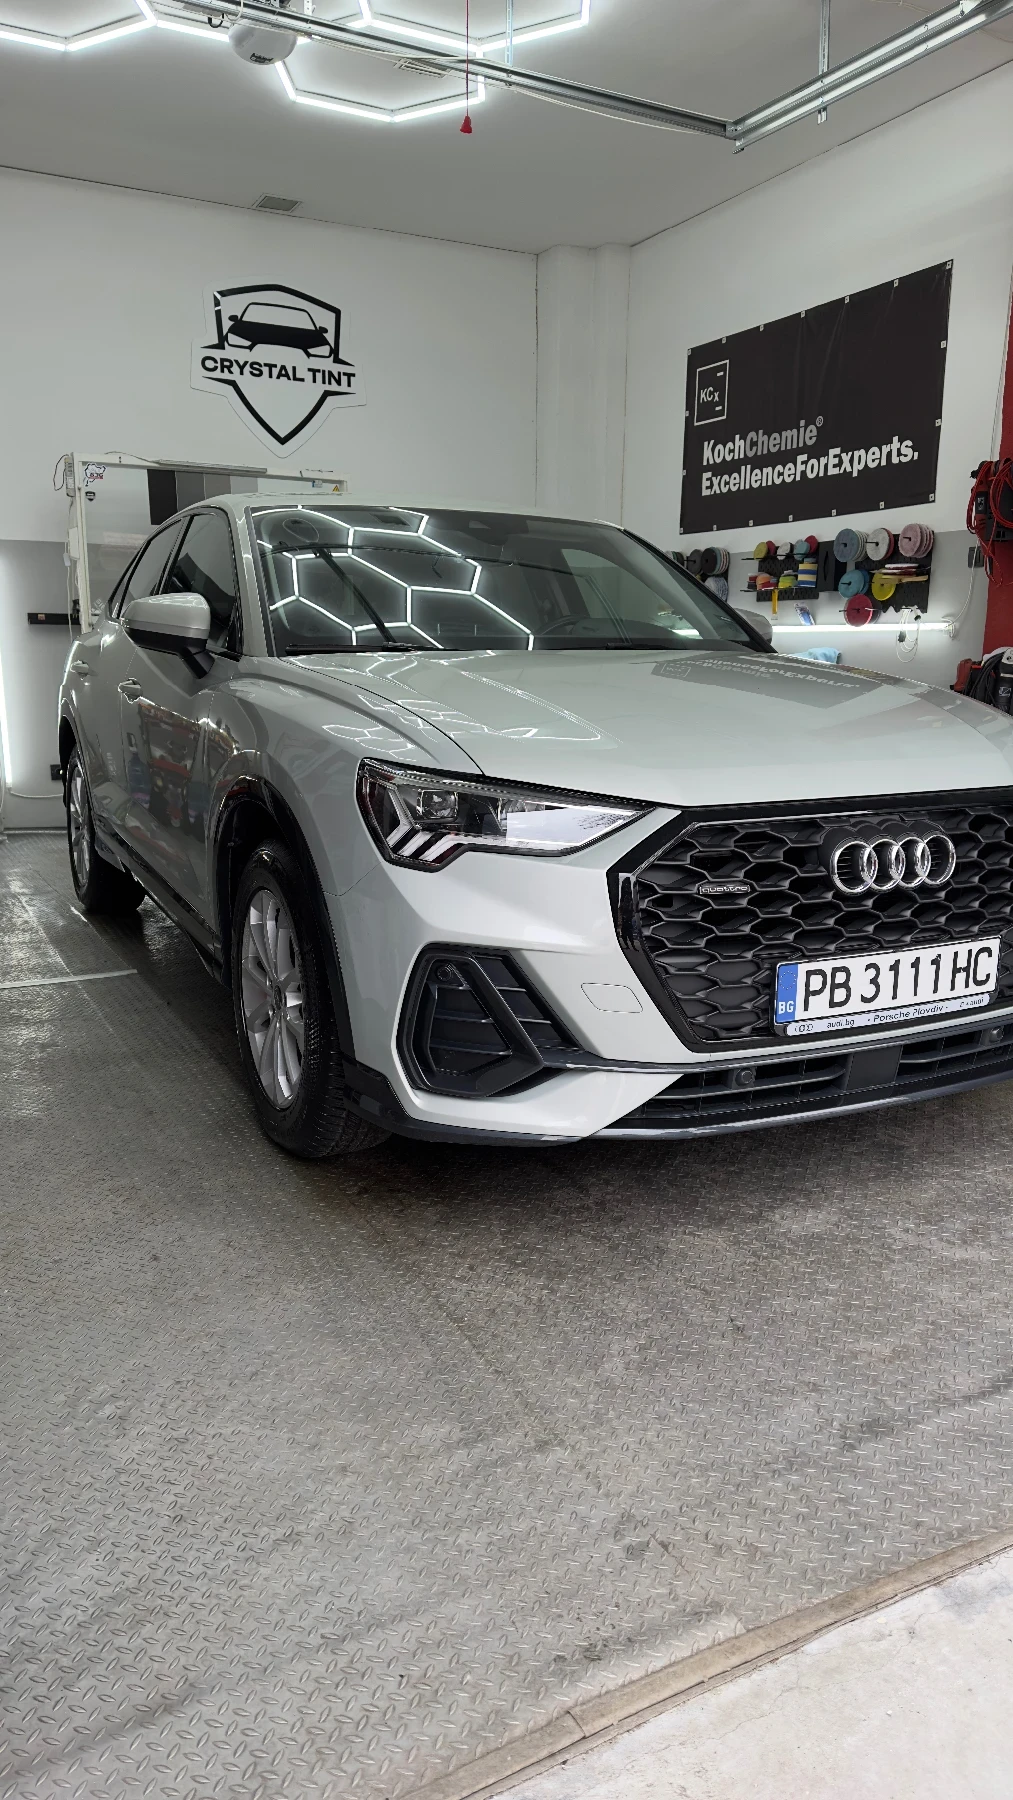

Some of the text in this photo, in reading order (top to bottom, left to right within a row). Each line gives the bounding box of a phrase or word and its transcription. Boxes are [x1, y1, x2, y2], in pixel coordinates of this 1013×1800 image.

[200, 355, 356, 388] CRYSTAL TINT
[701, 435, 919, 496] ExcellenceForExperts.
[701, 886, 748, 894] quattro
[778, 1000, 795, 1015] BG
[826, 1018, 855, 1029] audi.bg
[873, 1009, 911, 1023] Porsche
[912, 1004, 944, 1016] Plovdiv
